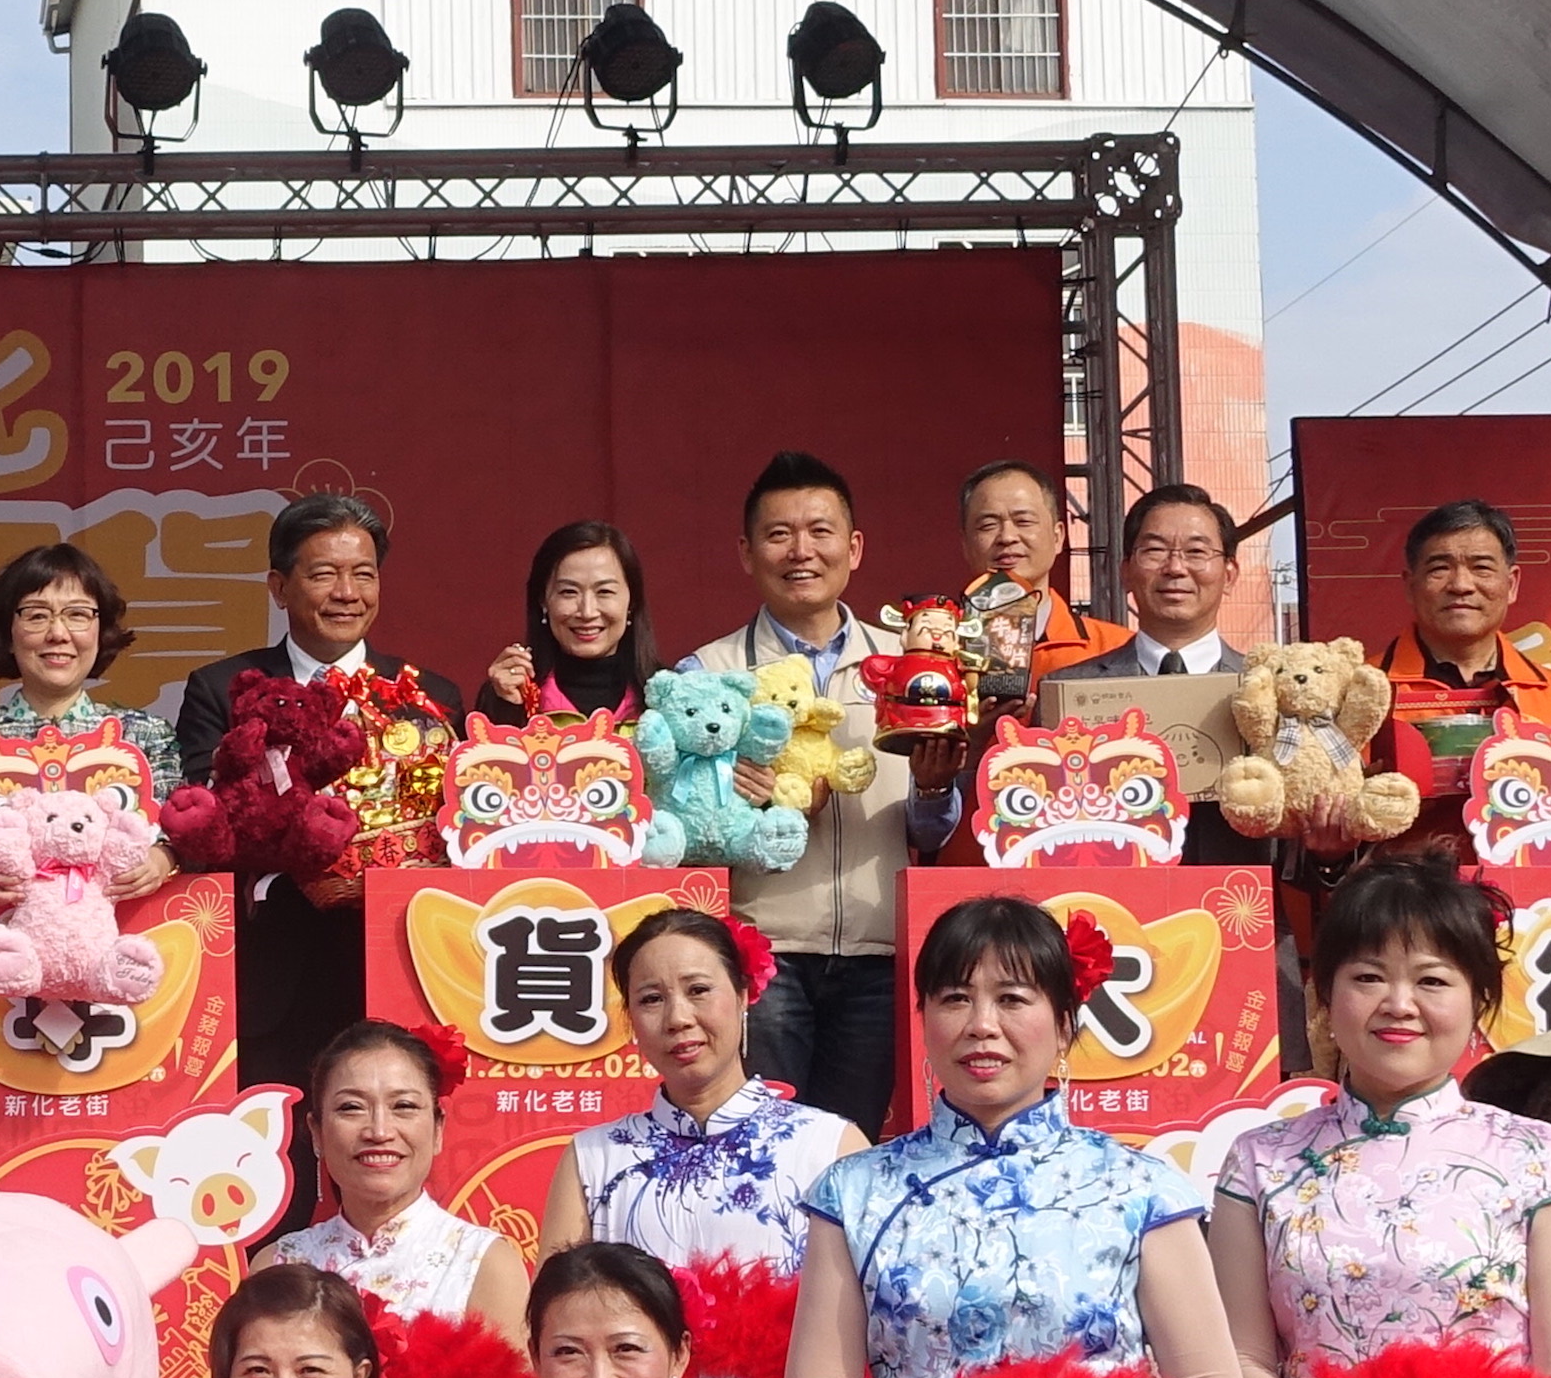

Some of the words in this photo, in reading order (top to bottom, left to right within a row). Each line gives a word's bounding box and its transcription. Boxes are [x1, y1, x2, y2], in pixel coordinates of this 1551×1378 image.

[104, 348, 292, 405] 2019
[103, 415, 293, 473] 己亥年
[379, 836, 400, 864] 春
[486, 914, 603, 1035] 貨
[3, 1094, 110, 1117] 新化老街
[496, 1089, 603, 1113] 新化老街
